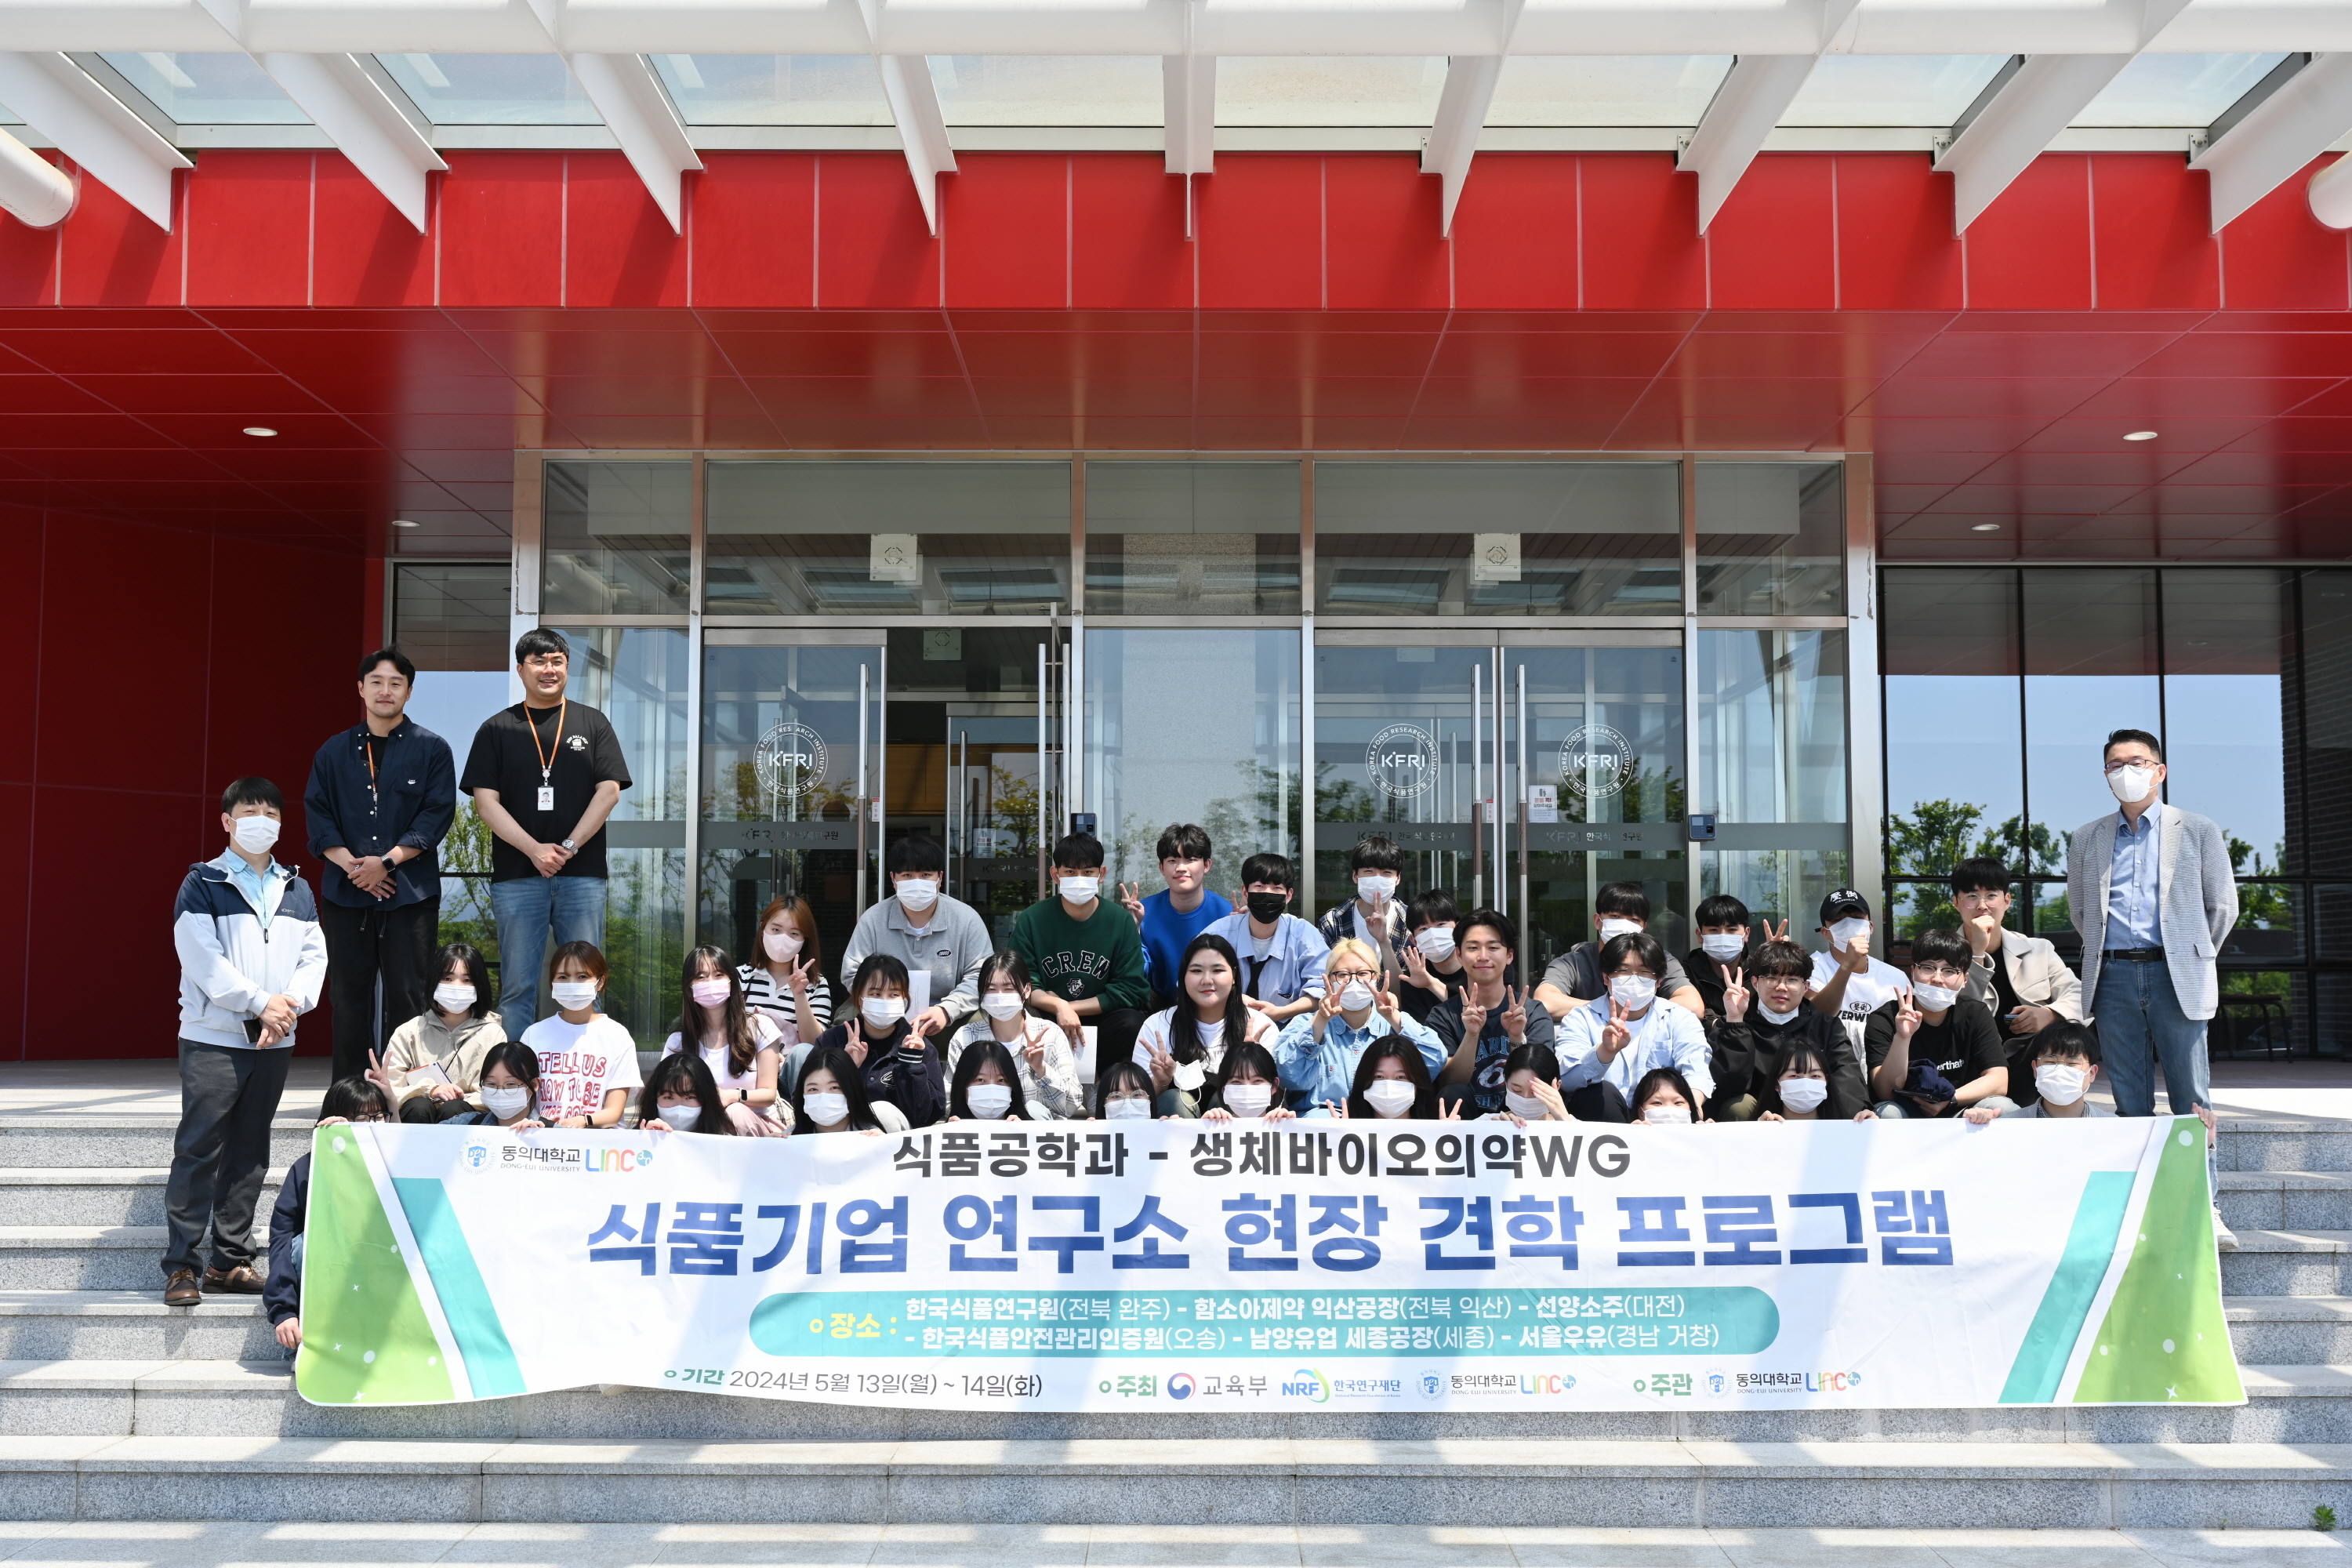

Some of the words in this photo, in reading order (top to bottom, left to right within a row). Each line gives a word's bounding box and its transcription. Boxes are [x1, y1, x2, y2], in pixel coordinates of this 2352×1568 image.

[760, 731, 777, 748] FOOD
[779, 726, 814, 739] RESARCH
[813, 739, 825, 774] INSTITUTE
[769, 750, 812, 770] KFRI
[1373, 731, 1388, 749] FOOD
[1391, 728, 1426, 740] RESEARCH
[1426, 739, 1438, 775] INSTITUTE
[1381, 751, 1425, 771] KFRI
[1565, 732, 1581, 750] FOOD
[1582, 728, 1618, 740] RESEARCH
[1618, 739, 1630, 775] INSTITUTE
[1573, 752, 1617, 771] KFRI
[1041, 950, 1110, 979] CREW
[539, 1052, 579, 1074] TELL
[582, 1054, 607, 1077] US
[583, 1081, 601, 1107] BE
[501, 1145, 581, 1163] 동의대학교
[892, 1131, 1129, 1178] 식품공학과
[1190, 1132, 1631, 1178] 생체바이오의약WG
[586, 1196, 909, 1276] 식품기업
[943, 1194, 1190, 1274] 연구소
[1222, 1192, 1388, 1272] 현장
[1420, 1194, 1584, 1271] 견학
[1617, 1189, 1954, 1266] 프로그램
[906, 1298, 1111, 1321] 한국식품연구원(전북
[1119, 1297, 1170, 1321] 완주)
[1194, 1297, 1305, 1321] 함소아제약
[1312, 1296, 1451, 1320] 익산공장(전북
[1459, 1296, 1511, 1319] 익산)
[1536, 1294, 1685, 1318] 선양소주(대전)
[829, 1313, 880, 1339] 장소
[922, 1327, 1225, 1350] 한국식품안전관리인증원(오송)
[1250, 1327, 1337, 1349] 남양유업
[1345, 1326, 1494, 1350] 세종공장(세종)
[1519, 1325, 1659, 1348] 서울우유(경남
[1668, 1323, 1719, 1347] 거창)
[682, 1368, 725, 1385] 기간
[729, 1370, 808, 1390] 2024년
[815, 1374, 849, 1392] 5월
[856, 1374, 938, 1396] 13일(월)
[961, 1374, 1042, 1397] 14일(화)
[1116, 1375, 1157, 1397] 주최
[1203, 1375, 1268, 1396] 교육부
[1282, 1382, 1319, 1396] NRF
[1334, 1380, 1401, 1392] 한국연구재단
[1451, 1374, 1516, 1388] 동의대학교
[1651, 1373, 1693, 1396] 주관
[1736, 1373, 1802, 1387] 동의대학교
